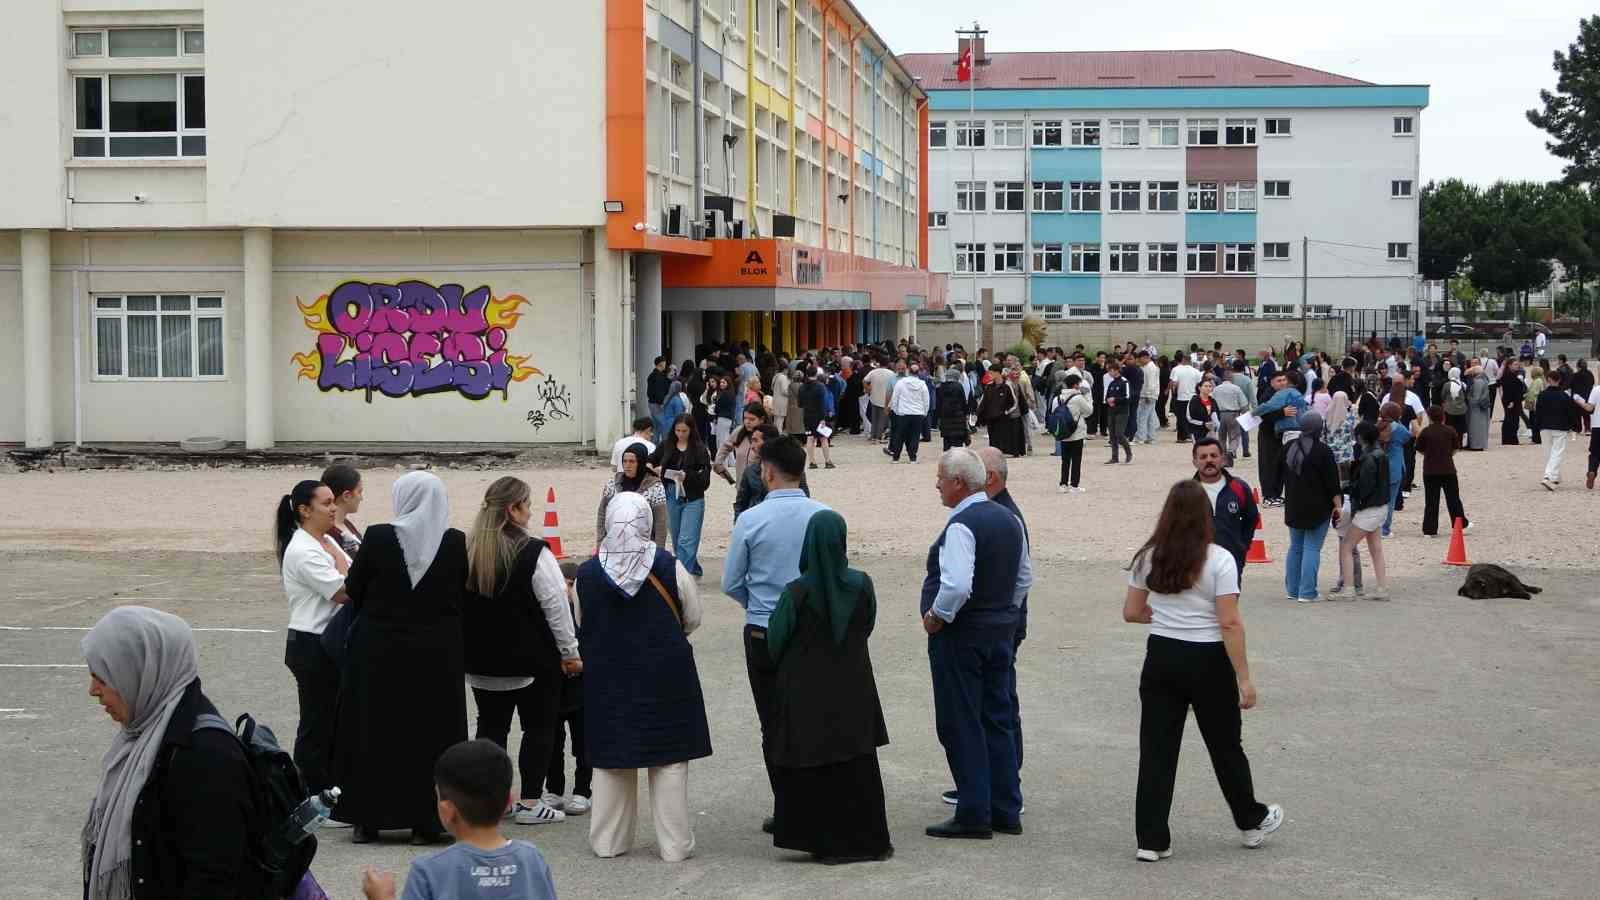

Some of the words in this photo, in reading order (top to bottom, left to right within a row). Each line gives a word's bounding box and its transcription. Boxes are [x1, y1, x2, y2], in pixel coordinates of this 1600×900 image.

[745, 250, 764, 264] A
[740, 267, 768, 276] BLOK
[327, 280, 491, 336] ORDU
